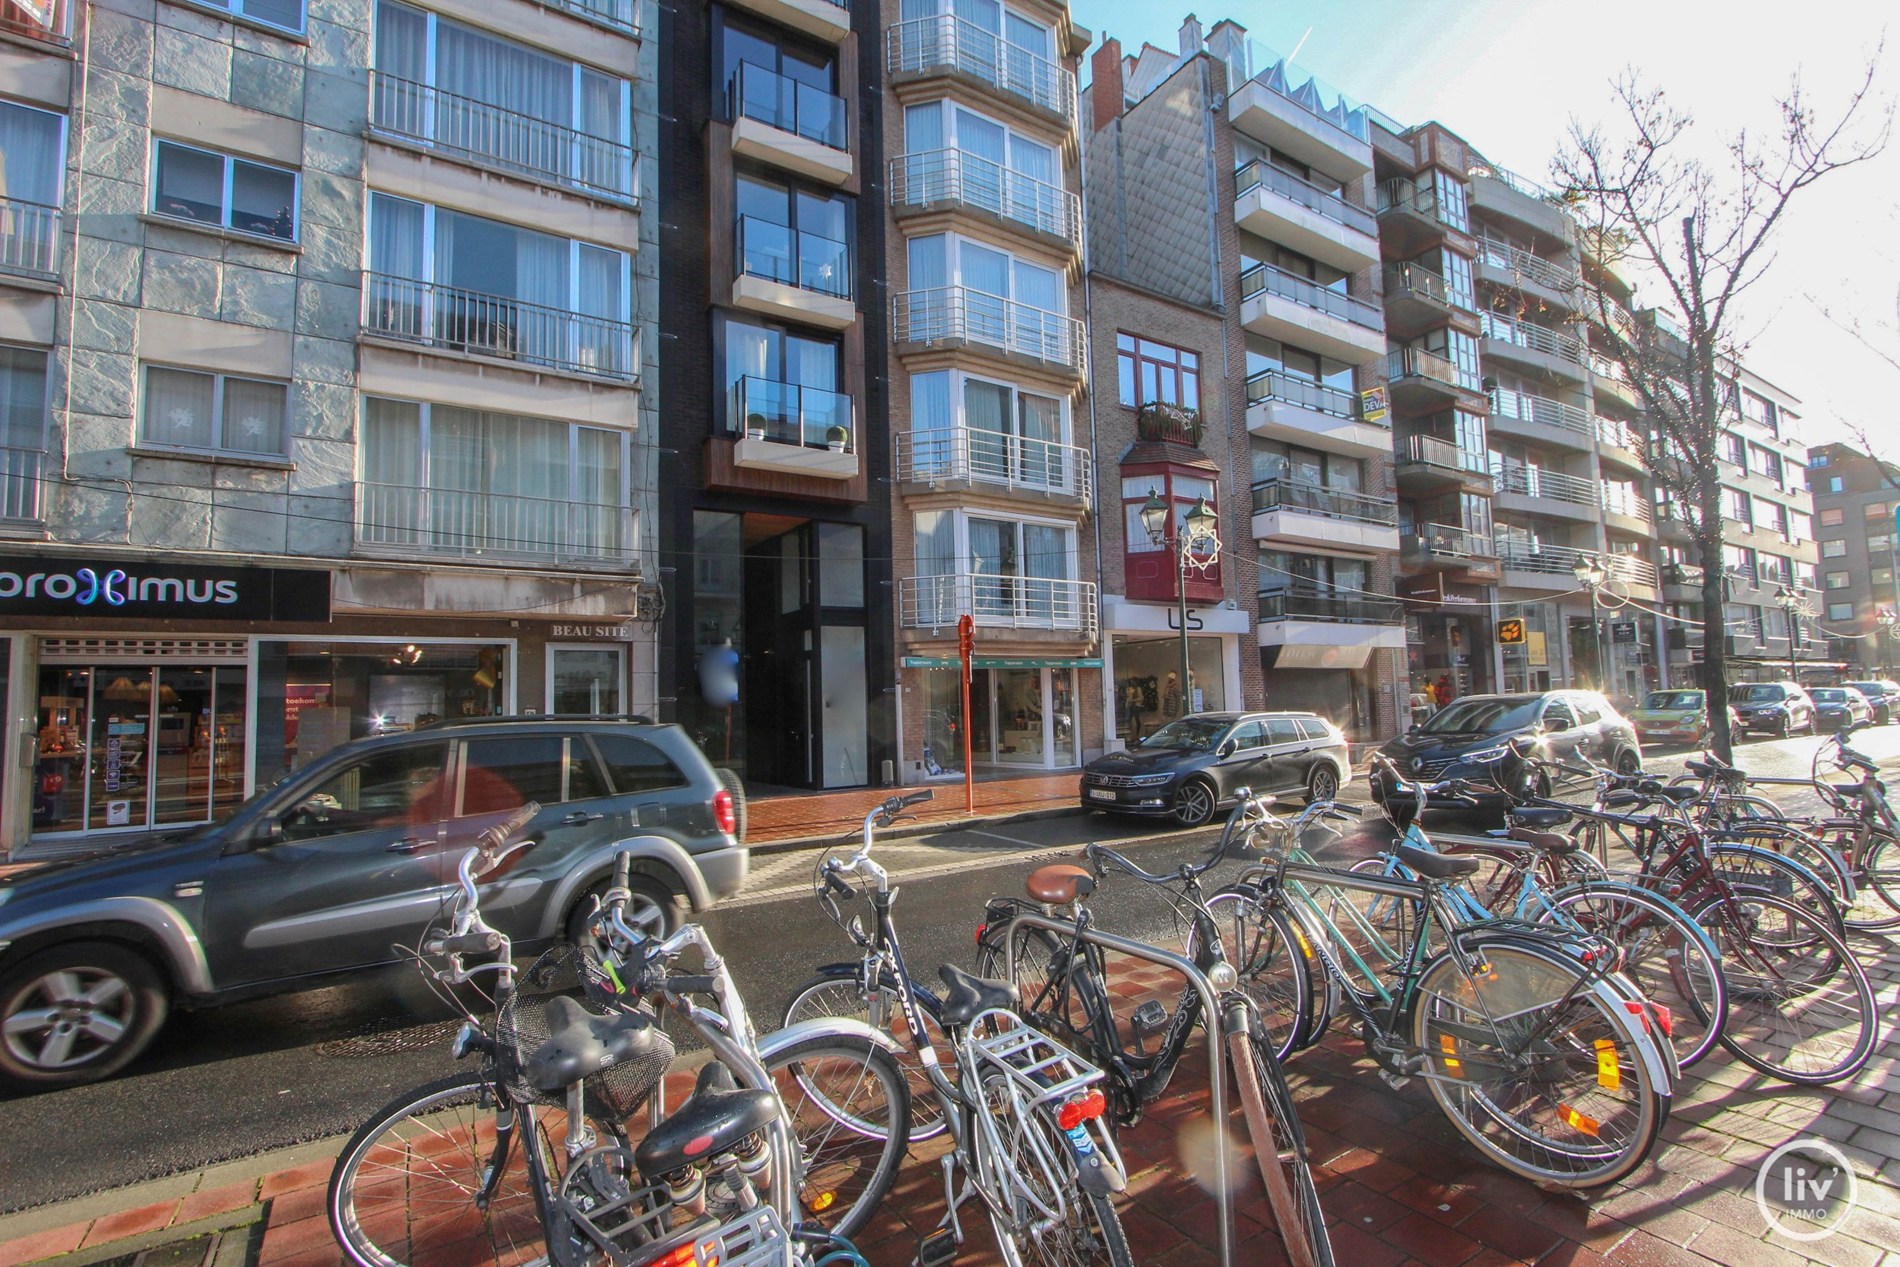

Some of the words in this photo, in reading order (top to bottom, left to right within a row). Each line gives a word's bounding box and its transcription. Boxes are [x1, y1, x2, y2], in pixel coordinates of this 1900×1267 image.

[552, 625, 592, 637] BEAU
[595, 625, 629, 638] SITE
[884, 937, 919, 1036] OXFORD
